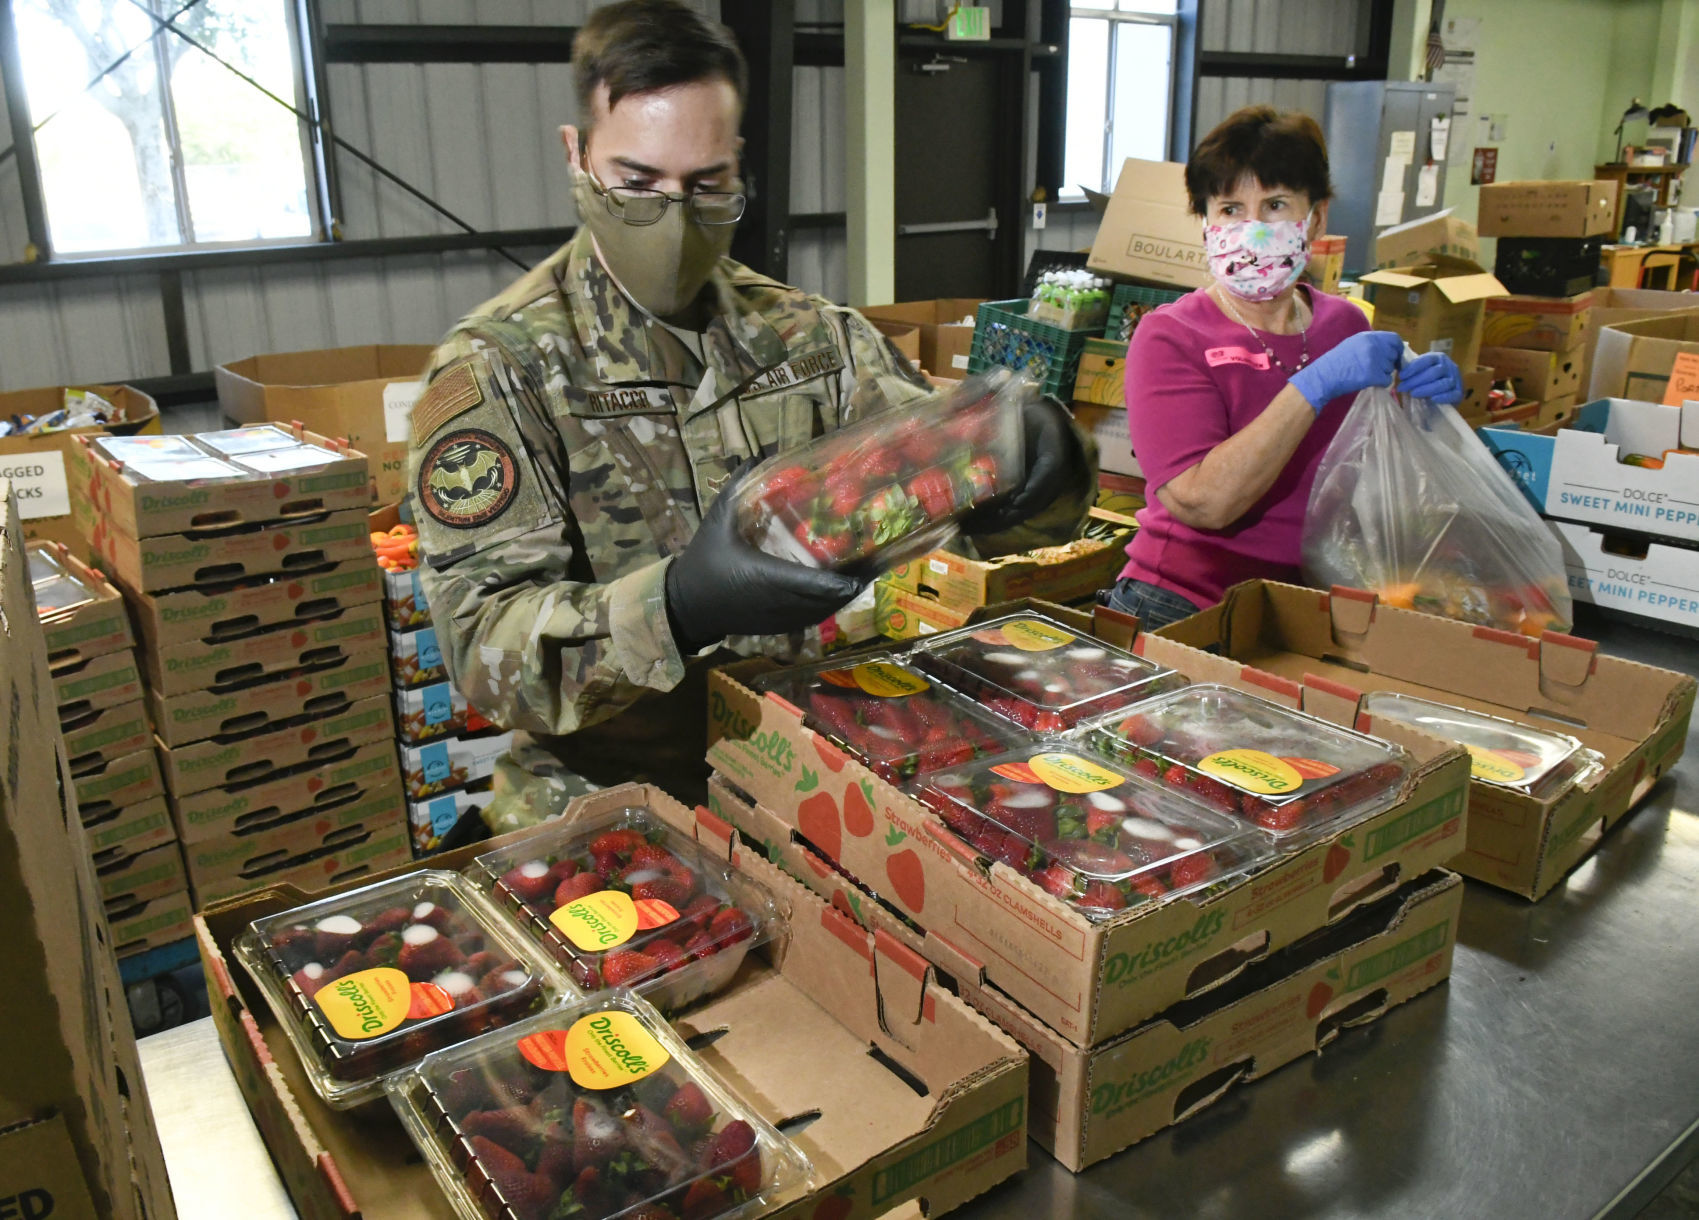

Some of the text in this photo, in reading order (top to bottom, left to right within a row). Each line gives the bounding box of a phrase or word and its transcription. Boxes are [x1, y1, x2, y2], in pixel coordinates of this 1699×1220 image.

[956, 8, 983, 36] EXIT
[1133, 240, 1206, 264] BOULART
[766, 367, 791, 388] AIR
[789, 351, 838, 381] FORCE
[1560, 492, 1699, 526] SWEET MINI PEPP
[1598, 582, 1633, 599] MINI
[1638, 590, 1699, 614] PEPPER
[884, 806, 952, 864] Strawberries
[568, 904, 619, 945] Driscoll's
[1003, 894, 1063, 941] CLAMSHELLS
[1105, 907, 1229, 985] Driscoll's
[335, 980, 384, 1033] Driscoll's
[589, 1016, 650, 1074] Driscoll's
[1091, 1036, 1213, 1115] Driscoll's
